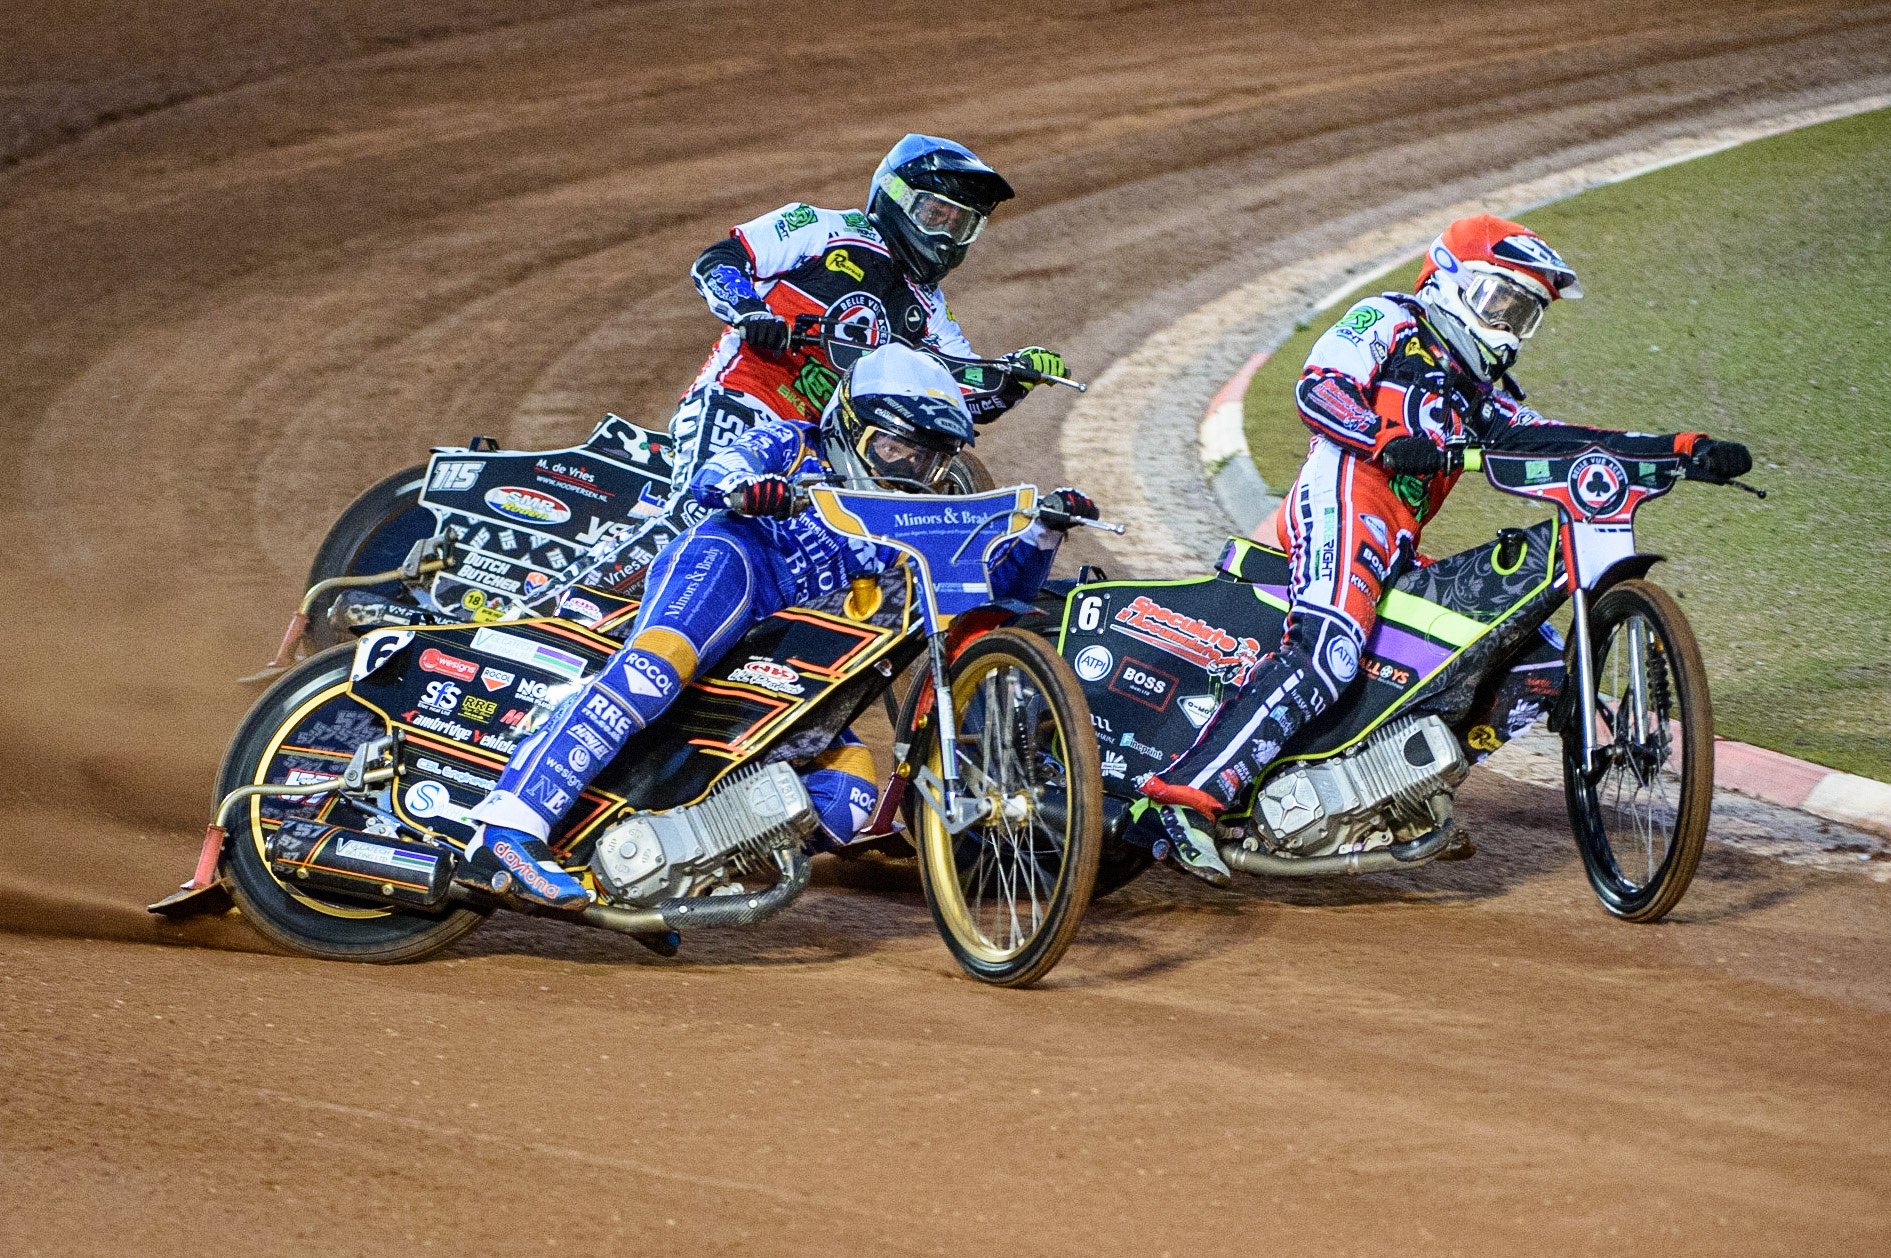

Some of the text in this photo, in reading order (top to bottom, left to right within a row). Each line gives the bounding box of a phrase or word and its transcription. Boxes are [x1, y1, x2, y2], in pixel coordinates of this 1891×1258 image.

[840, 297, 865, 310] BELLE
[878, 319, 887, 345] ACES
[428, 461, 486, 491] 115
[535, 459, 595, 483] M. de Vries
[1572, 457, 1624, 481] BELLE VUE ACES
[505, 491, 556, 513] SMR
[894, 512, 943, 528] Minors
[943, 507, 960, 525] &
[463, 551, 511, 575] DUTCH
[457, 564, 521, 592] BUTCHER
[467, 594, 481, 606] 18
[664, 582, 699, 619] Minors
[684, 570, 707, 582] &
[1077, 597, 1102, 631] 6
[1129, 596, 1237, 651] Speculate
[438, 656, 476, 674] wesigns
[1081, 655, 1106, 672] ATPI
[1334, 646, 1356, 673] ATPI
[484, 668, 512, 684] ROCOL
[625, 652, 674, 695] ROCOL
[1122, 667, 1166, 693] BOSS
[516, 677, 555, 699] NG
[464, 696, 496, 713] RRE
[586, 693, 632, 735] RRE
[401, 710, 472, 741] Cambridge
[493, 842, 560, 899] daytona
